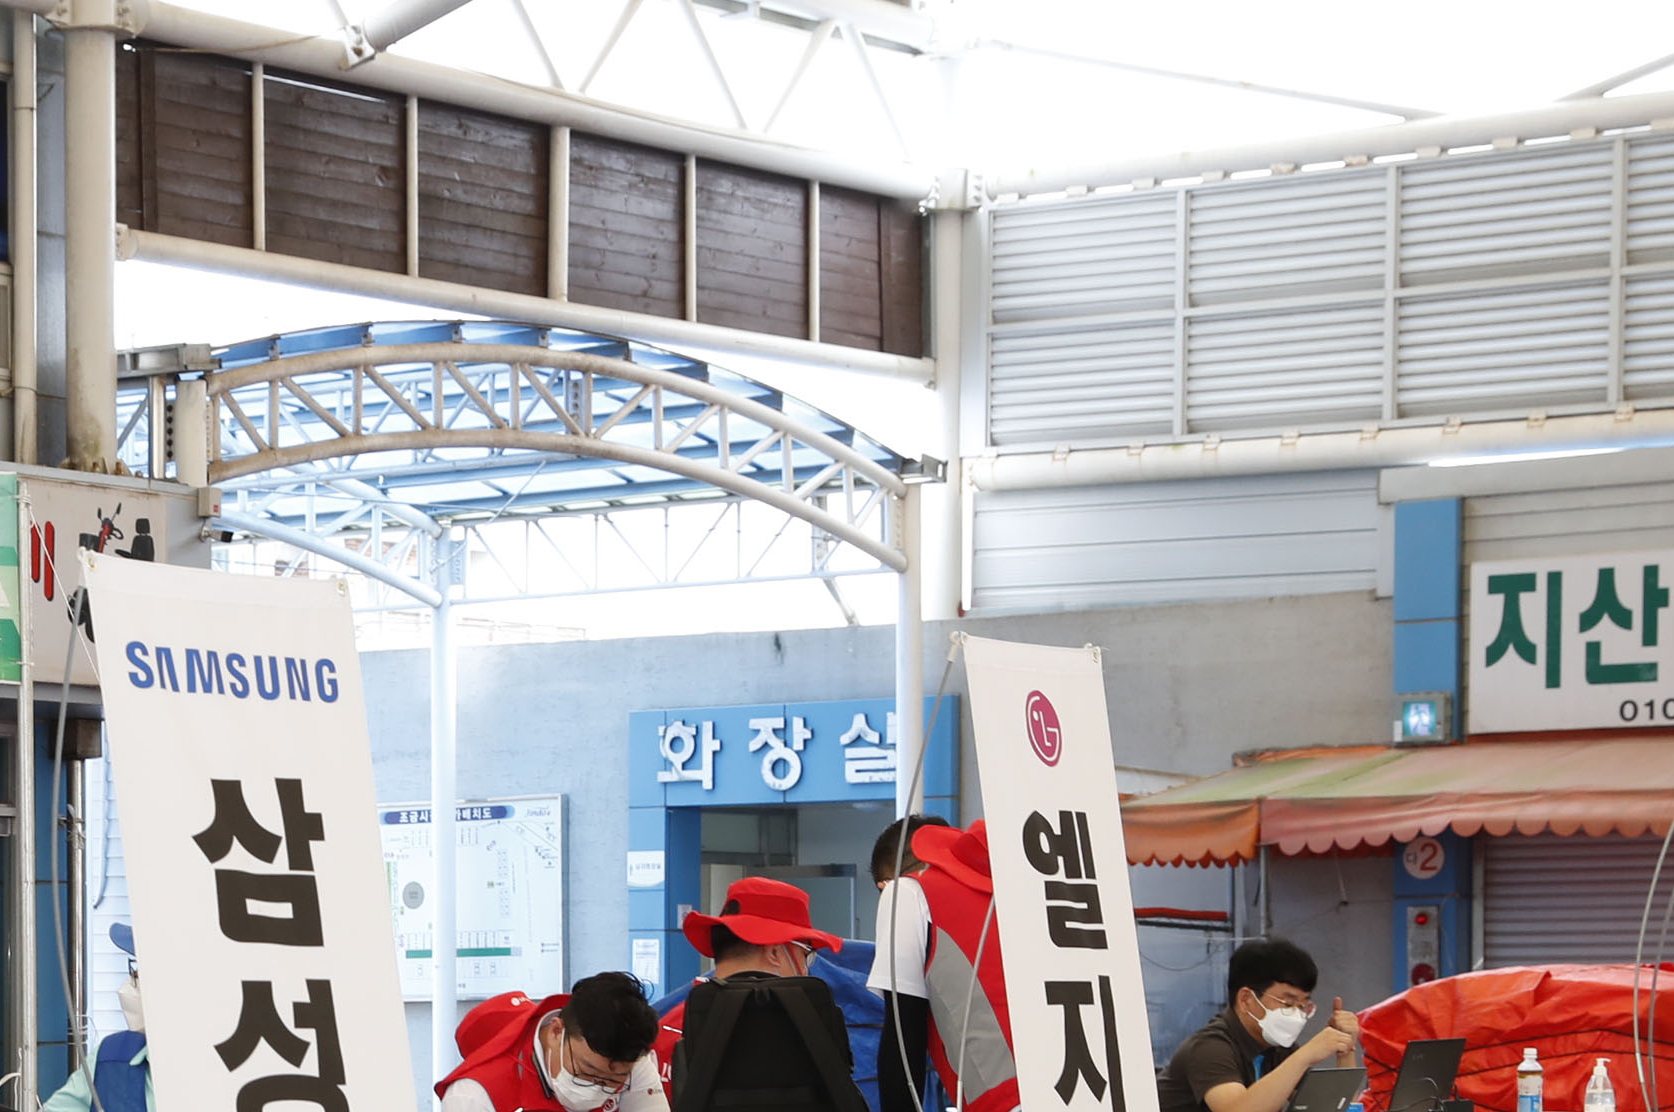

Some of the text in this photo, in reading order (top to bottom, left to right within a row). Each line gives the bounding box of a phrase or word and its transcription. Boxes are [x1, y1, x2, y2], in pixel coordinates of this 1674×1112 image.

[1485, 564, 1670, 690] 지산
[125, 641, 339, 704] SAMSUNG
[657, 712, 896, 791] 화장실
